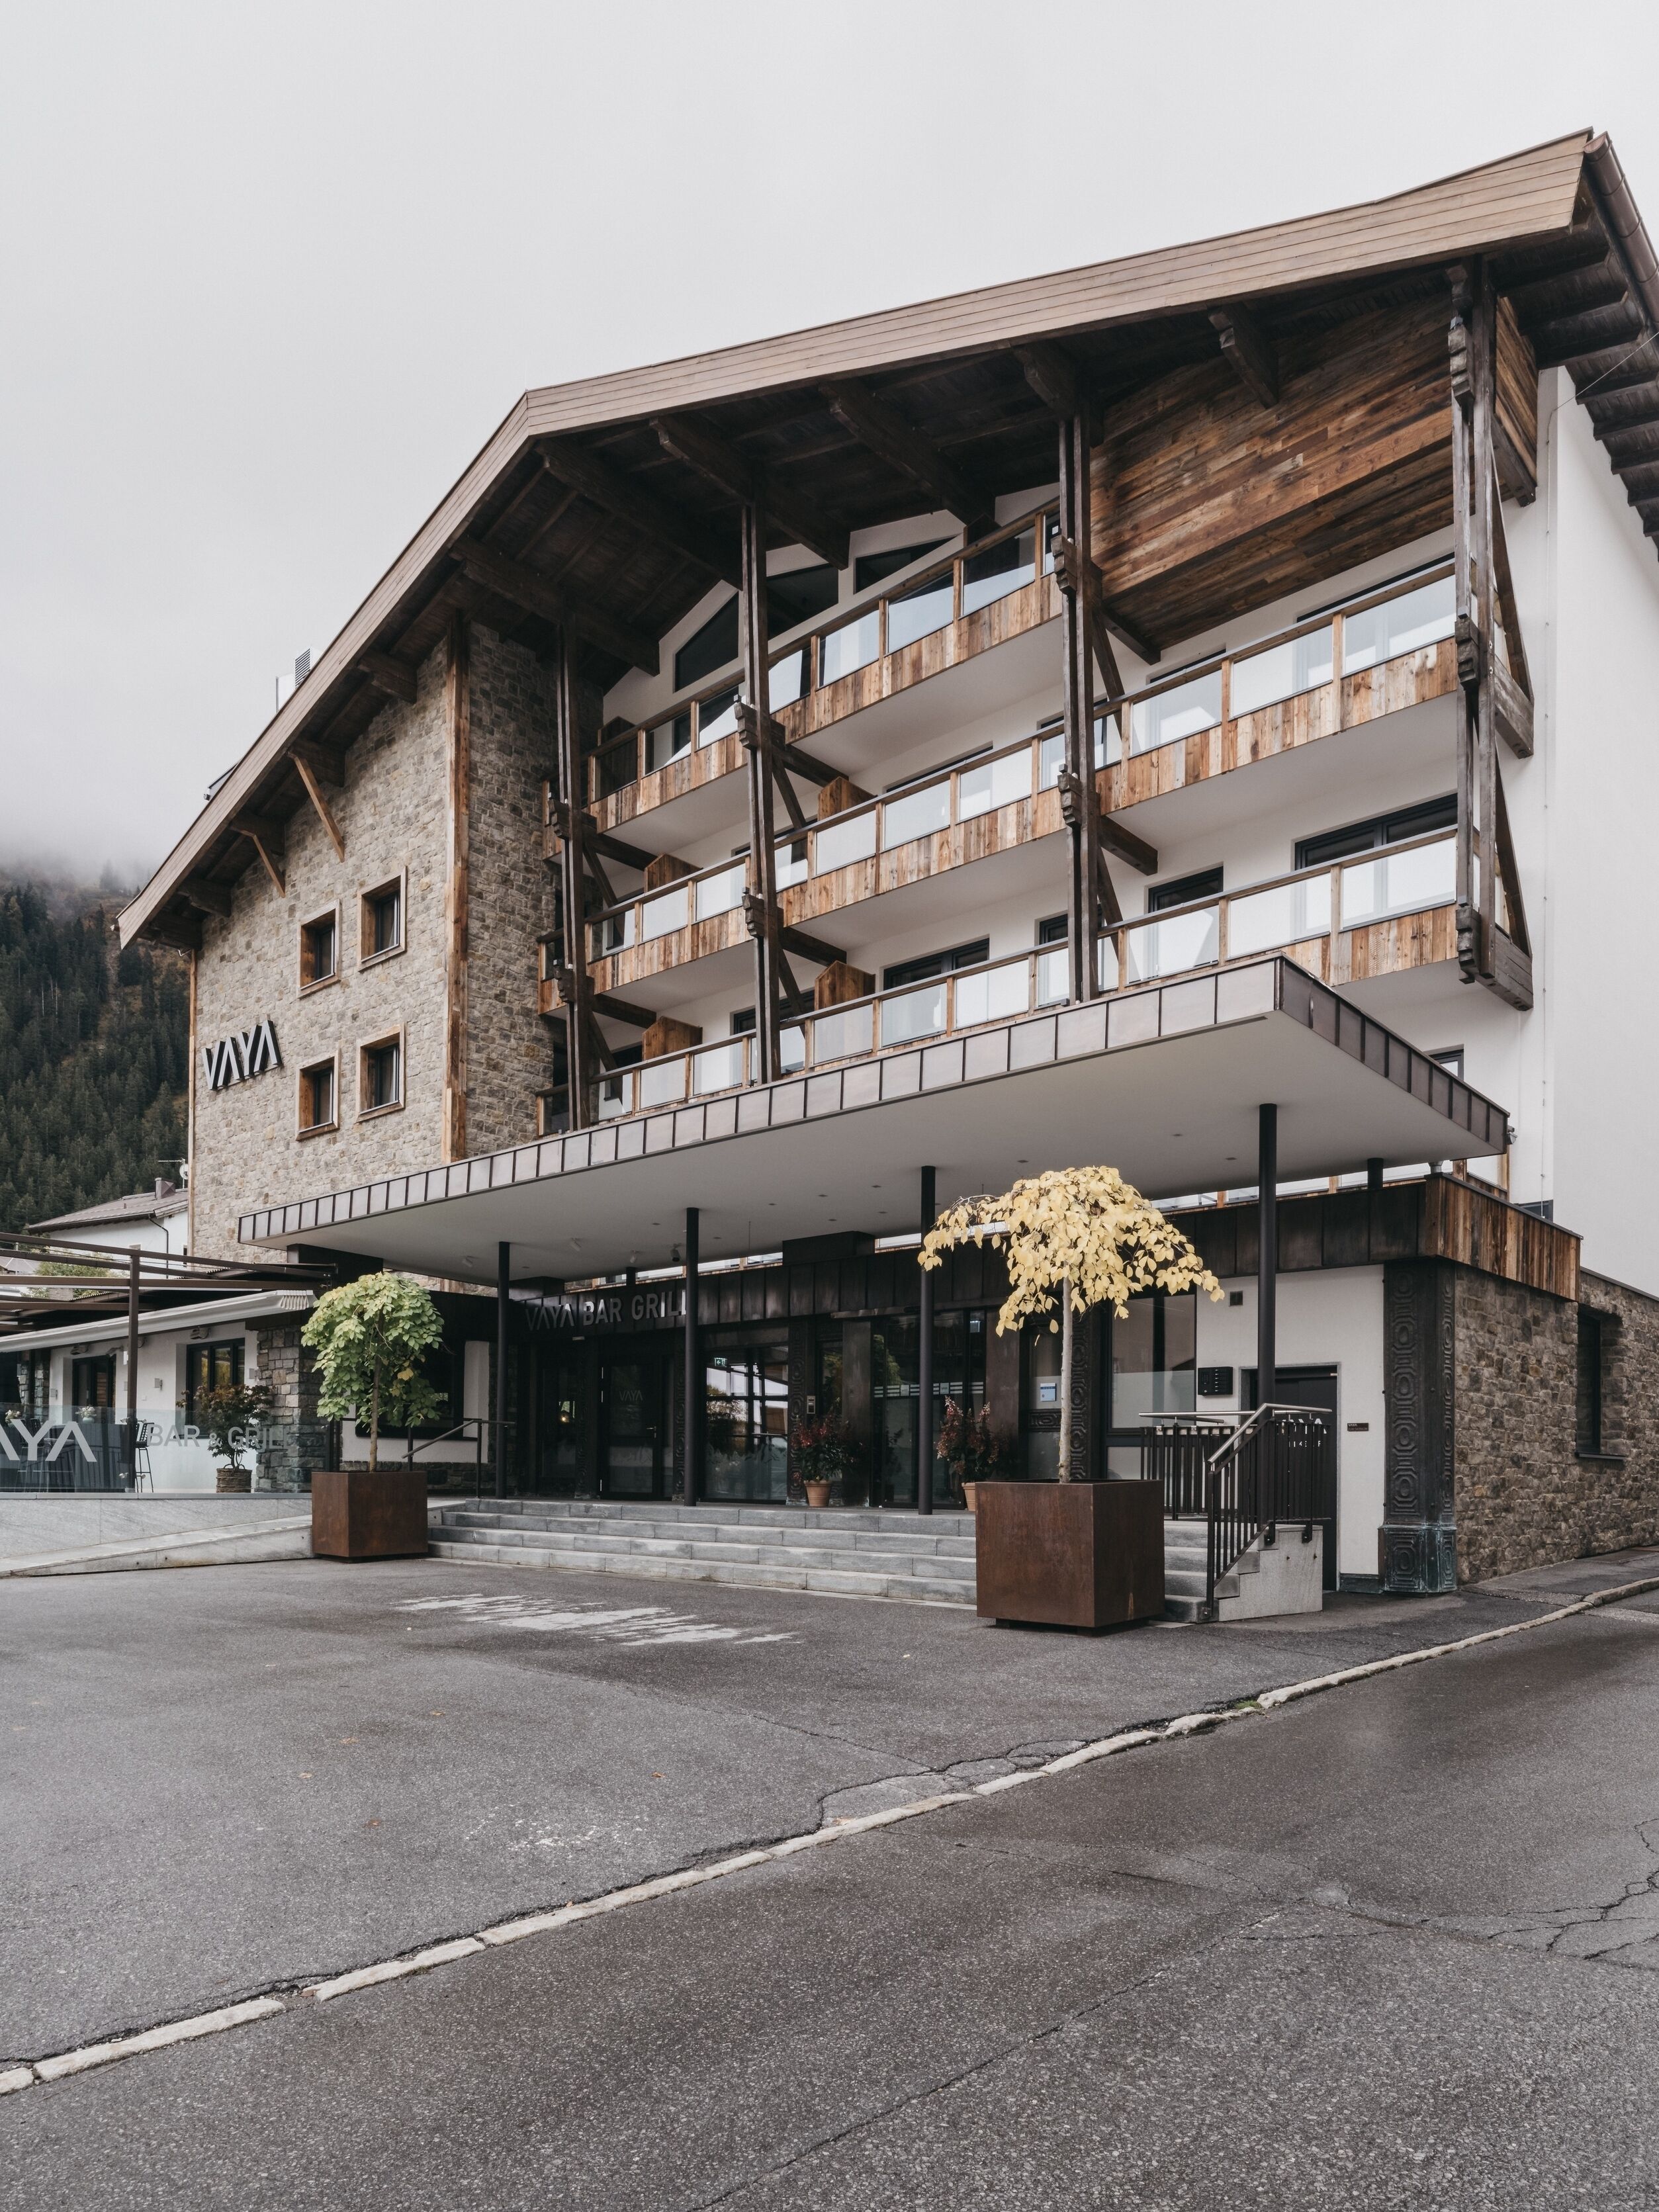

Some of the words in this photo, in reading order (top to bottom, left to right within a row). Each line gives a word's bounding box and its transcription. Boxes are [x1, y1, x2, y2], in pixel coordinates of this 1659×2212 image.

[201, 1020, 283, 1090] VAYA
[525, 1304, 575, 1331] VAYA
[583, 1298, 621, 1326] BAR
[619, 1390, 643, 1401] VAYA
[147, 1425, 200, 1447] BAR
[208, 1433, 222, 1448] &
